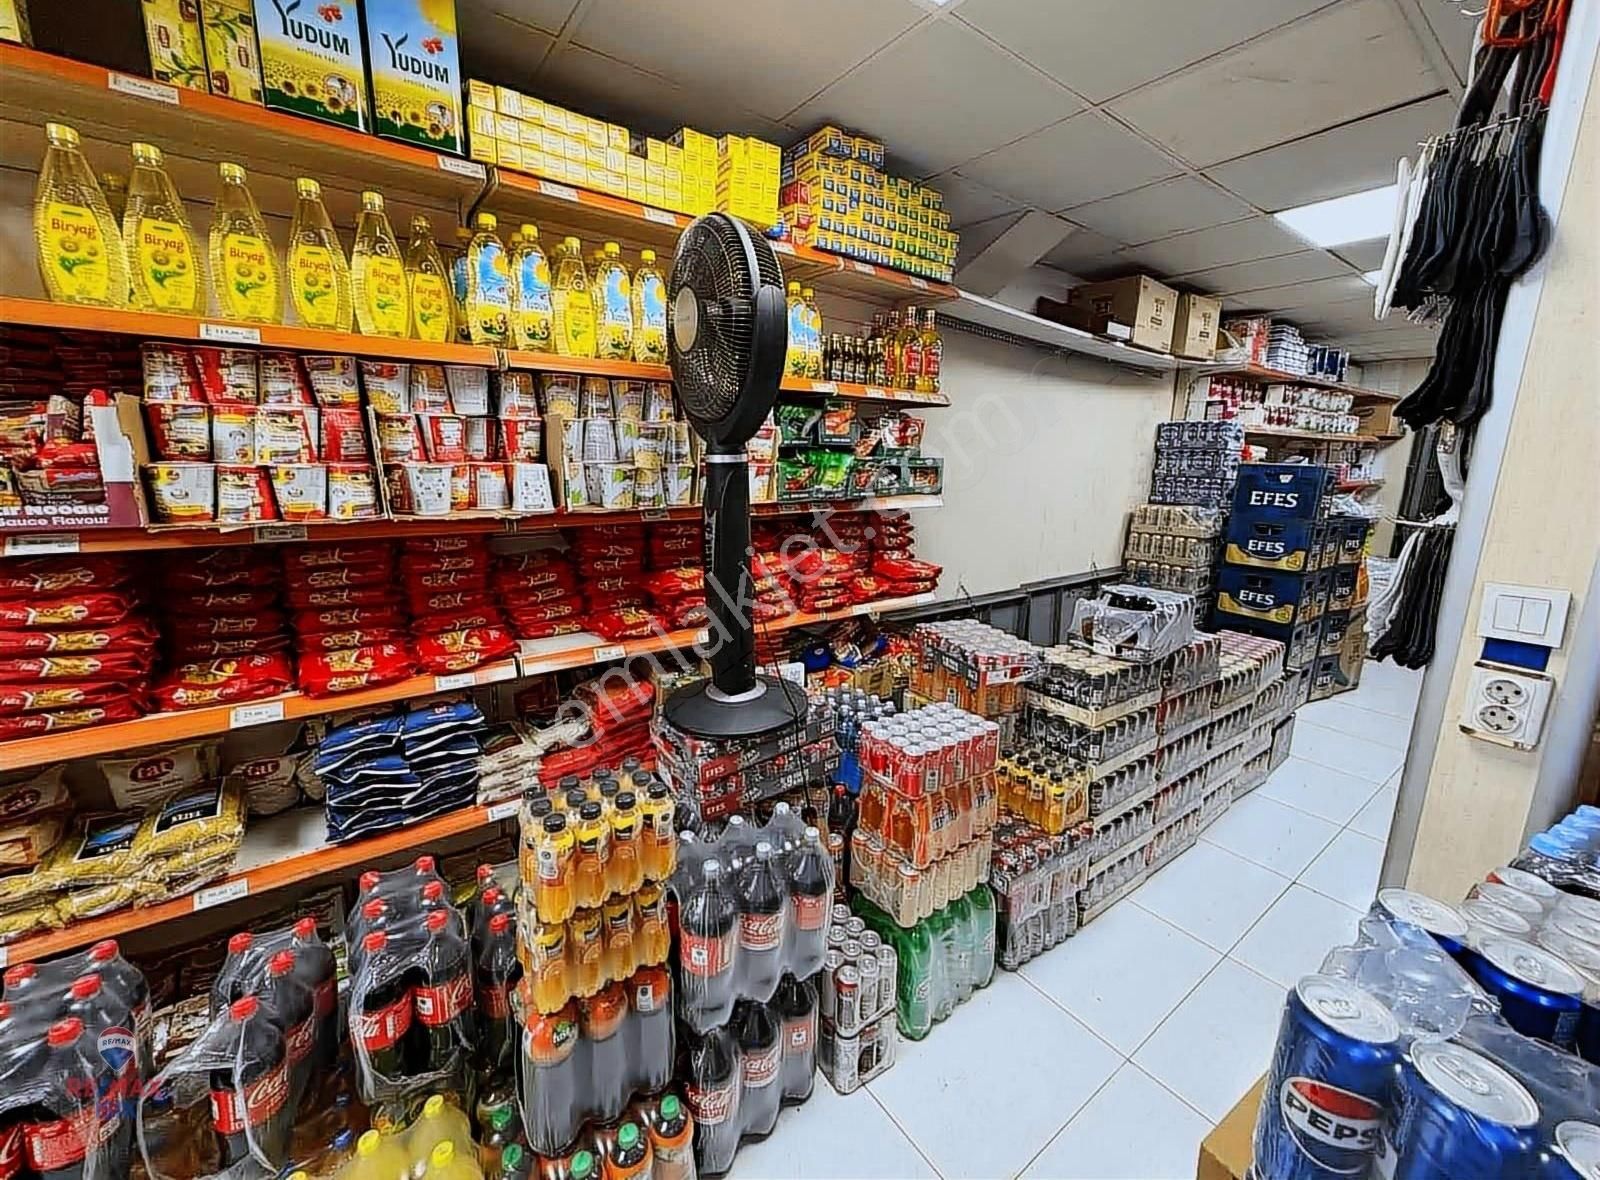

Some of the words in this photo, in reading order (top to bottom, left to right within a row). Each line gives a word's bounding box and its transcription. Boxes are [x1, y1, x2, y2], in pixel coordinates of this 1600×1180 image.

[380, 33, 449, 84] YUDUM
[1250, 491, 1299, 508] EFES
[24, 504, 110, 516] Noodle
[52, 516, 110, 526] Flavour
[1247, 539, 1285, 554] EFES
[1239, 589, 1275, 606] EFES
